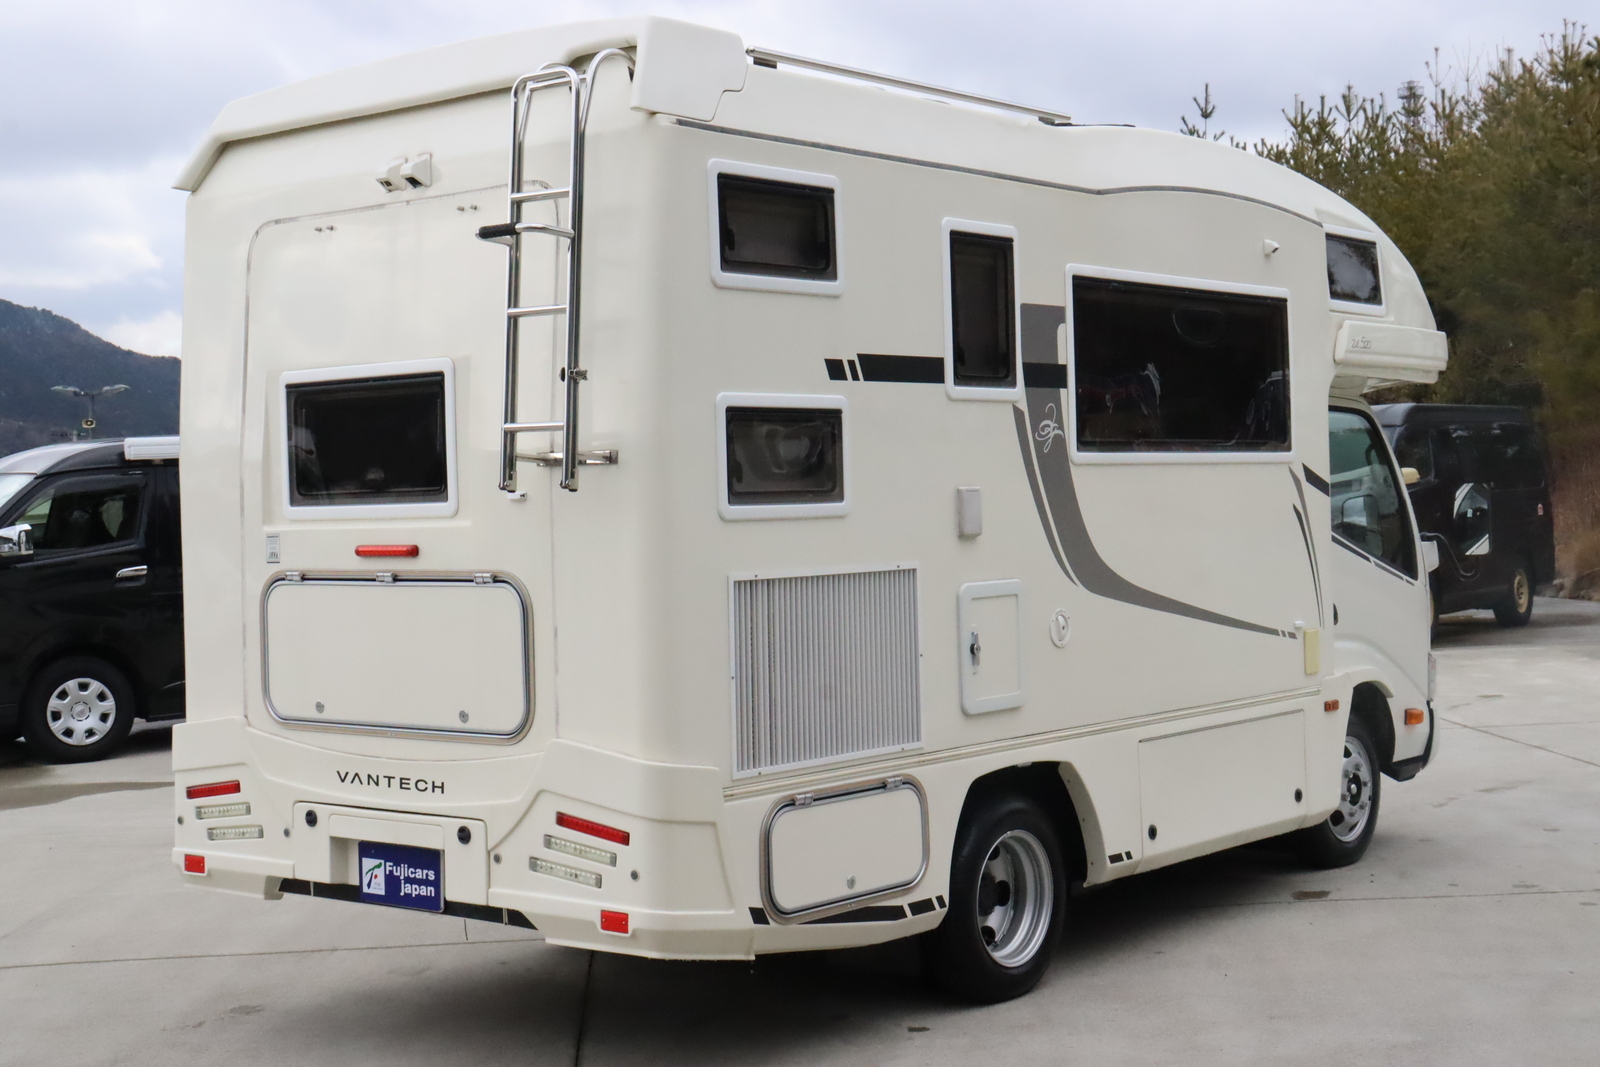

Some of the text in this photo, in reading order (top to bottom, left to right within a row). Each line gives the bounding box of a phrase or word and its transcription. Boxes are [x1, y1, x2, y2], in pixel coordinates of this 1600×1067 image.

[336, 770, 445, 794] VANTECH
[385, 861, 436, 881] Fujicars
[400, 880, 435, 898] japan
